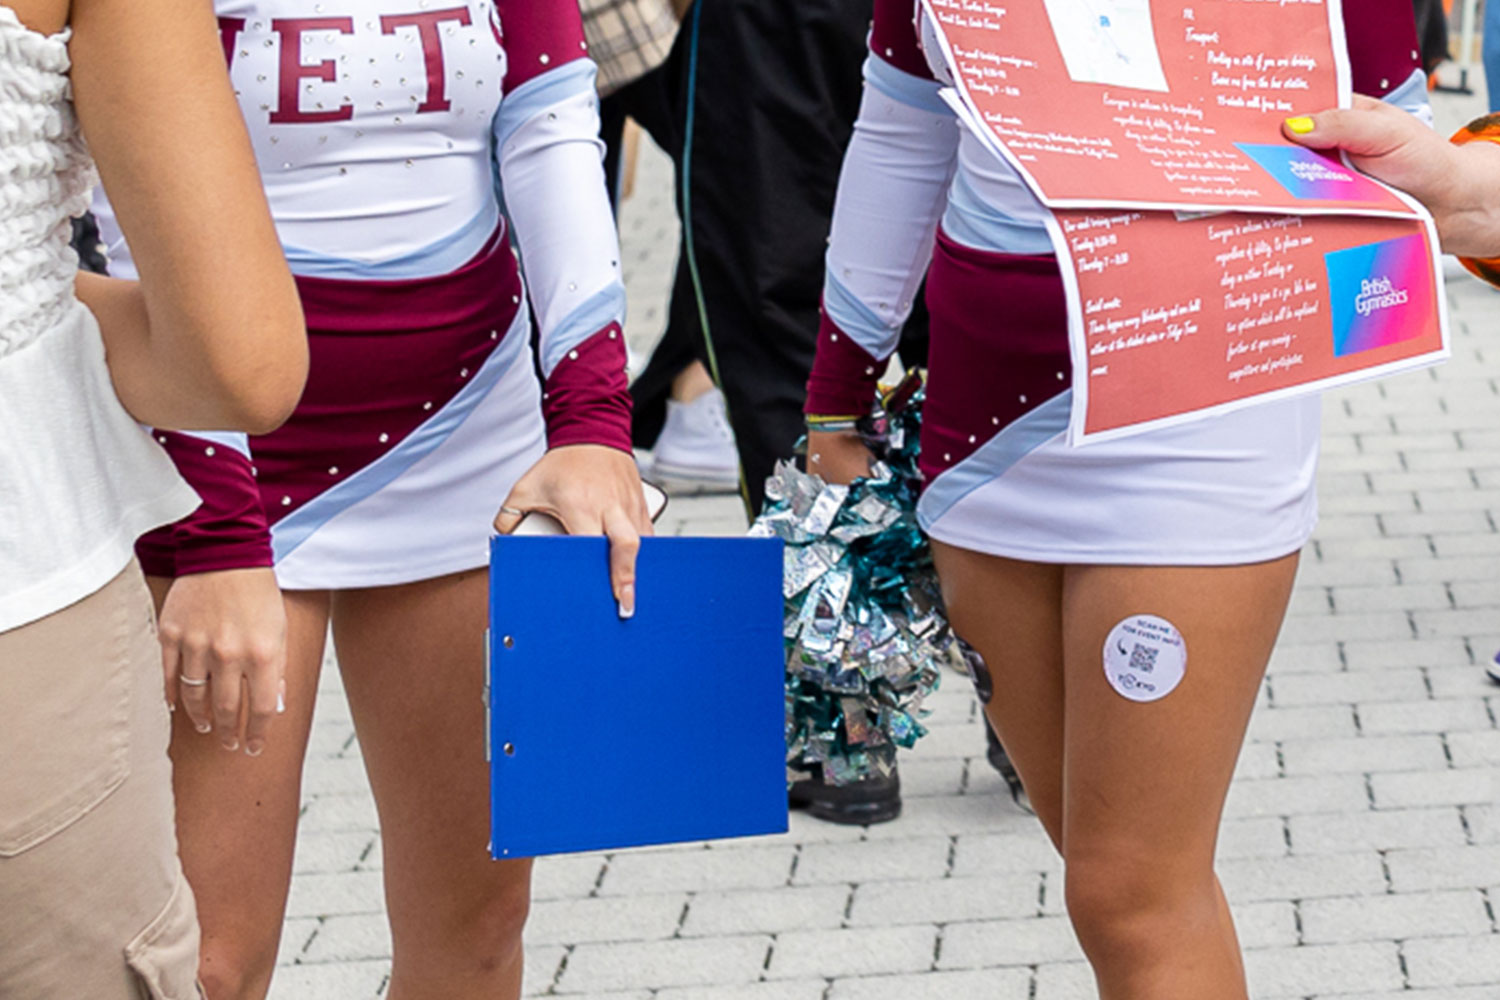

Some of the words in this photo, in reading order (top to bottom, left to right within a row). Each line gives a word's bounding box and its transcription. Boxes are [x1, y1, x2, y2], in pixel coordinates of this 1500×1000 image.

[1360, 276, 1392, 298] British
[1354, 288, 1409, 316] Gymnastics
[1138, 630, 1161, 641] EVENT
